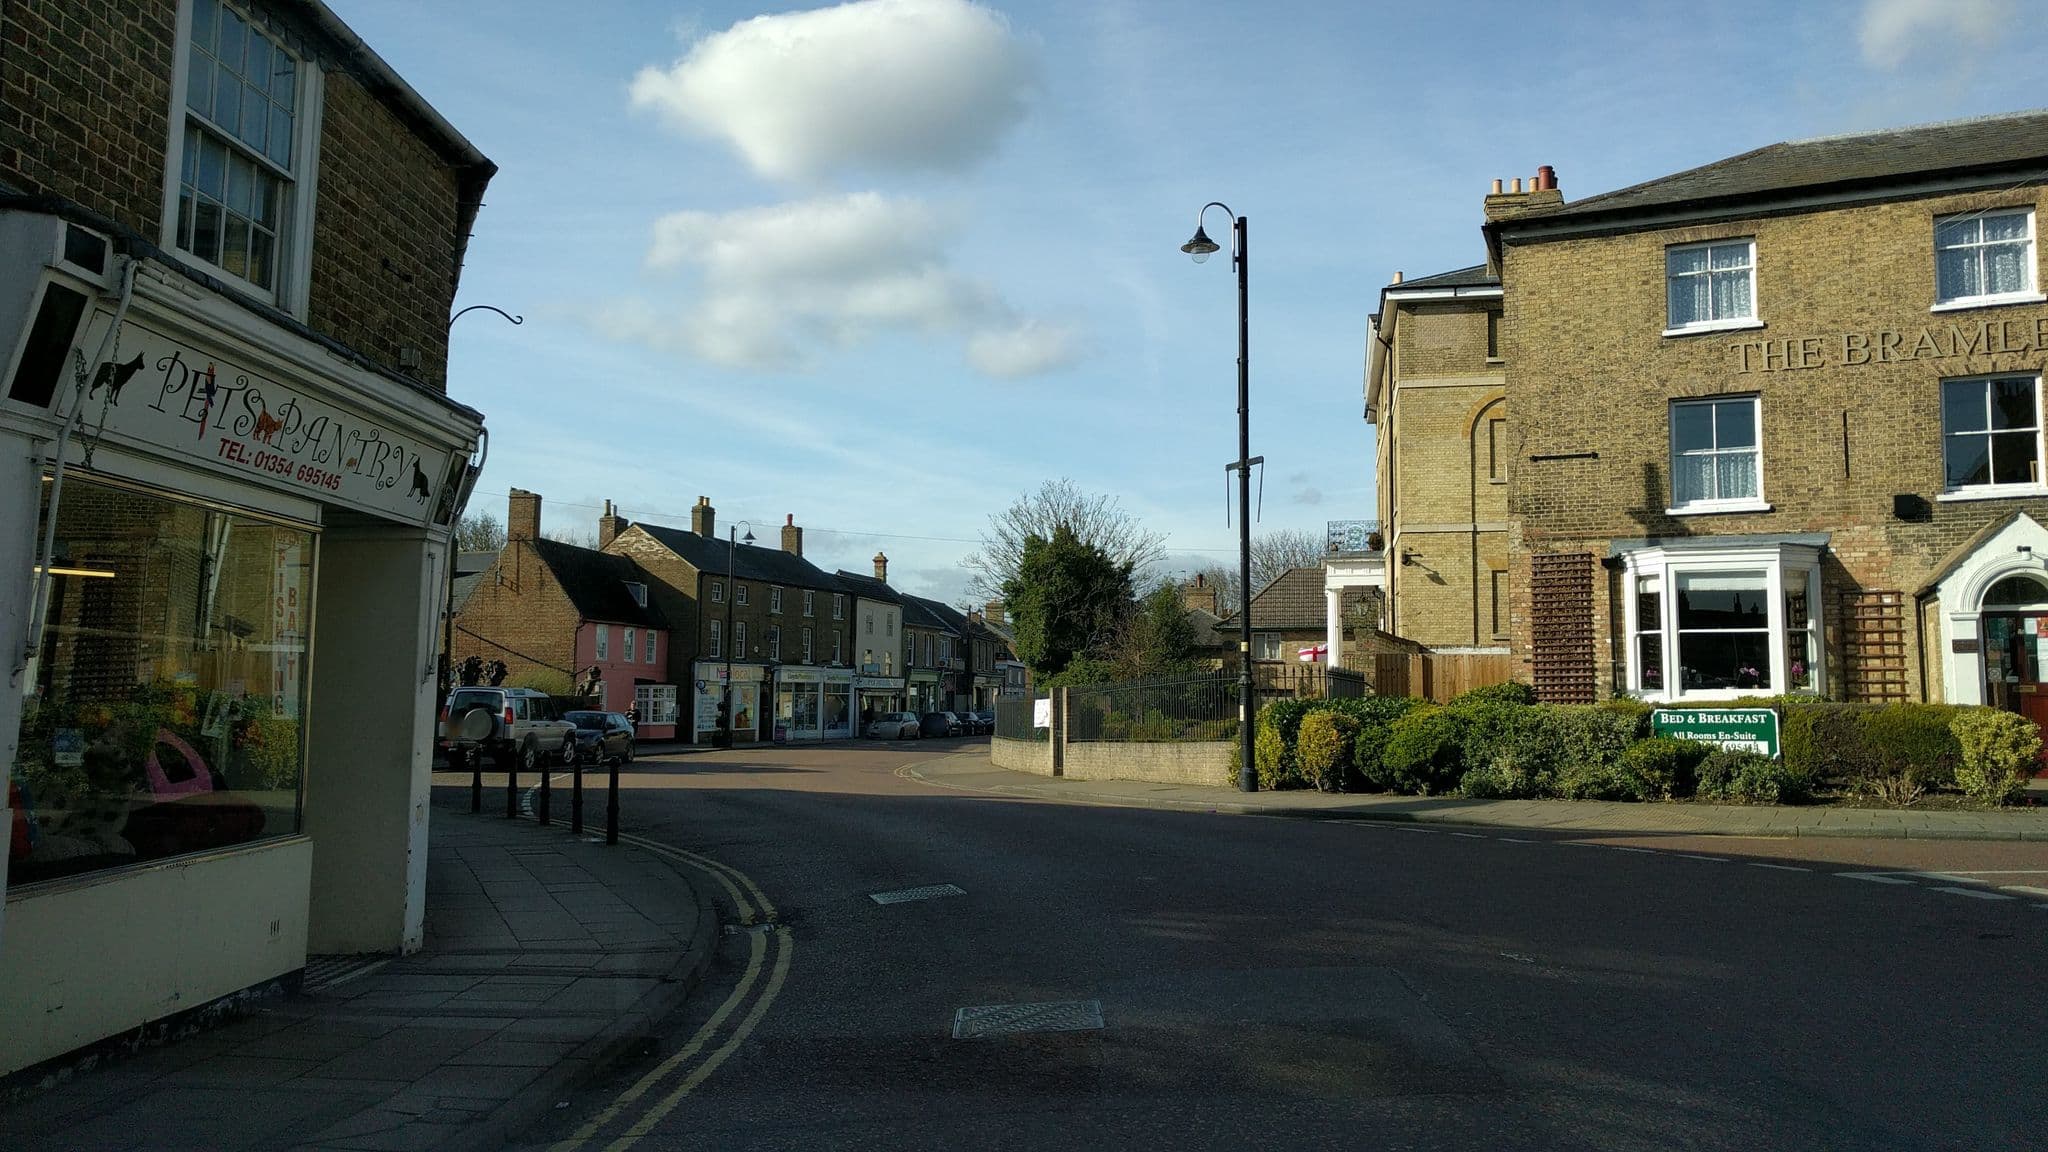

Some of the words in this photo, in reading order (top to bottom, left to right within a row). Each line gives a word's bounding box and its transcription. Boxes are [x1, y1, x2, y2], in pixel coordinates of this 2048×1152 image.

[1730, 337, 1826, 374] THE
[148, 351, 262, 437] PETS
[271, 397, 418, 491] PANTRY
[218, 438, 253, 465] TEL:
[254, 451, 294, 477] 01354
[296, 464, 342, 491] 695145
[1661, 713, 1684, 723] BED
[1687, 715, 1696, 724] &
[1698, 713, 1767, 723] BREAKFAST
[1673, 731, 1685, 740] All
[1687, 731, 1716, 740] Rooms
[1718, 731, 1757, 740] En-Suite
